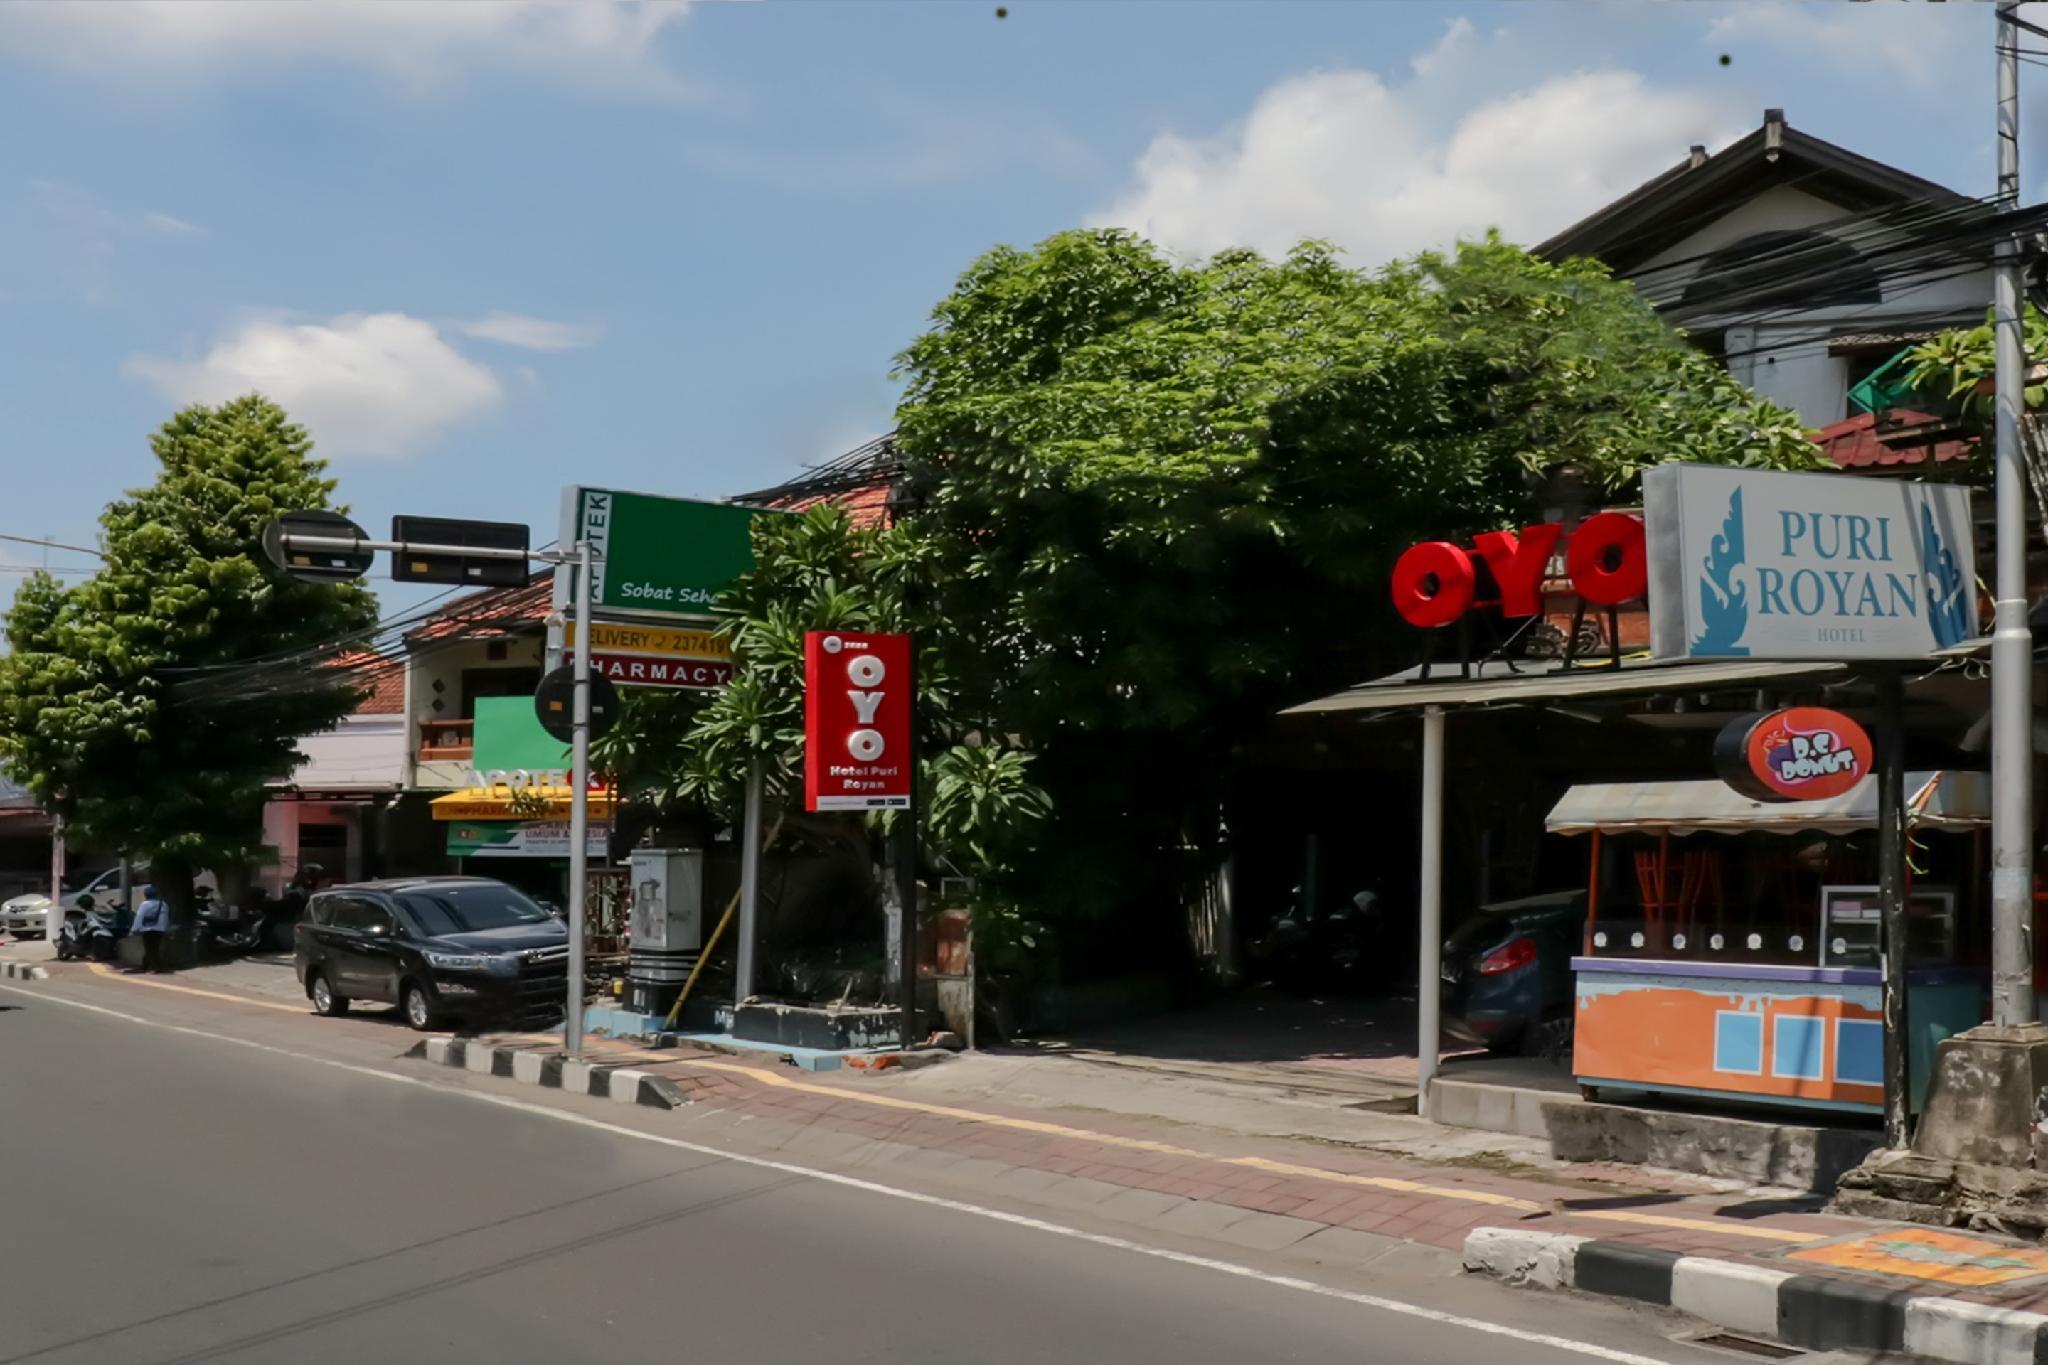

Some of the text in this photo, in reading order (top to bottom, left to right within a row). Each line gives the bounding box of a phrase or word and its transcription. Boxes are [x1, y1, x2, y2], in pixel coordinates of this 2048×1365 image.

[1778, 510, 1893, 562] PURI
[1391, 512, 1647, 628] OYO
[620, 582, 674, 601] Sobat
[1755, 567, 1918, 618] ROYAN
[590, 629, 650, 648] ELIVERY
[1816, 628, 1867, 643] HOTEL
[569, 657, 727, 683] HARMACY
[847, 654, 886, 762] OYO
[830, 765, 898, 777] Hotel Puri
[1780, 749, 1854, 780] DONUT
[842, 779, 886, 791] Royan
